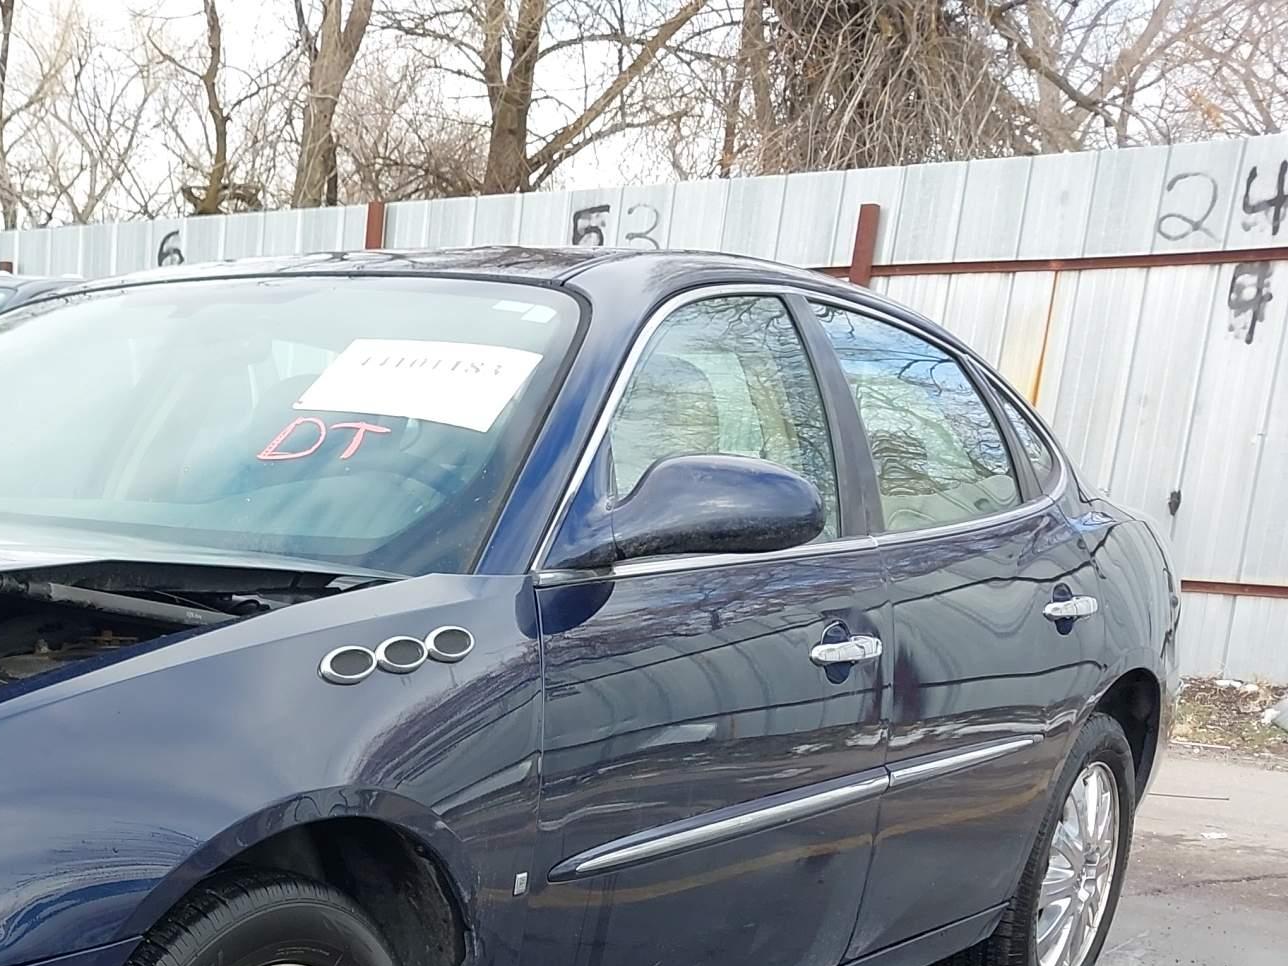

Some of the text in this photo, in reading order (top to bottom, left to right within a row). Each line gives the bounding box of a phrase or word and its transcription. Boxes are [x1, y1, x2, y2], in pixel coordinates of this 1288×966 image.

[1157, 172, 1222, 241] 2
[1243, 159, 1288, 236] 4
[572, 204, 610, 246] 5
[158, 230, 185, 267] 6
[257, 416, 392, 461] DT
